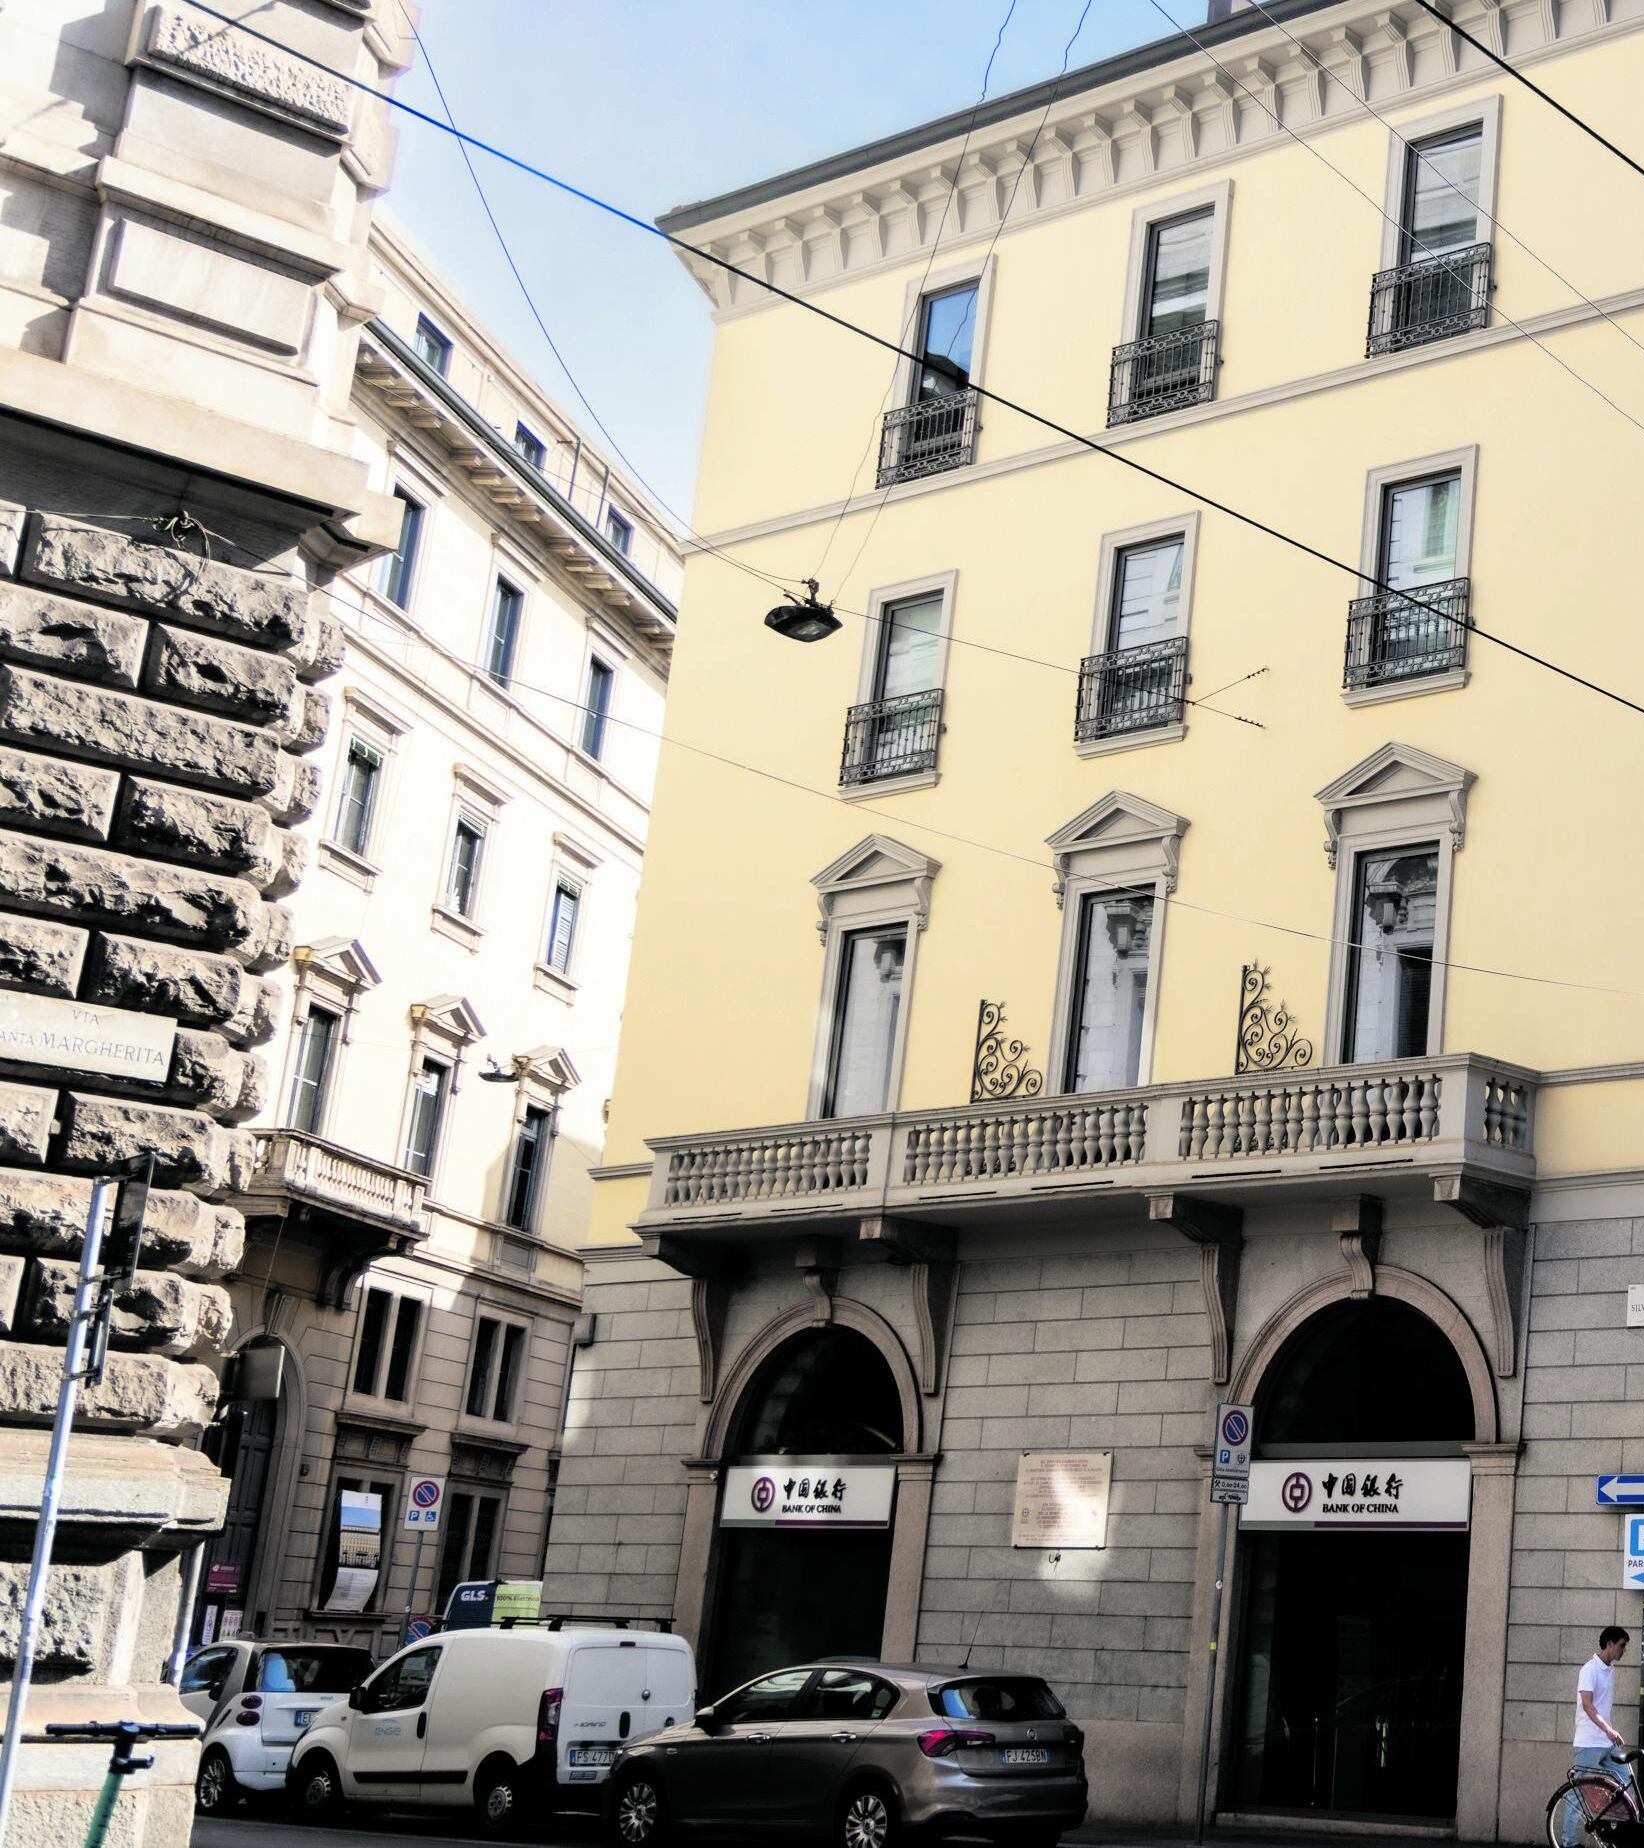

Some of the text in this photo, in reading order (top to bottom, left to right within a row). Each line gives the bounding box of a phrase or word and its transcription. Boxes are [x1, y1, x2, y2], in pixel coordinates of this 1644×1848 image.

[72, 1009, 100, 1025] VIA
[40, 1032, 165, 1066] MARGHERITA
[782, 1504, 842, 1514] BANK OF CHINA
[1322, 1504, 1399, 1513] BANK OF CHINA
